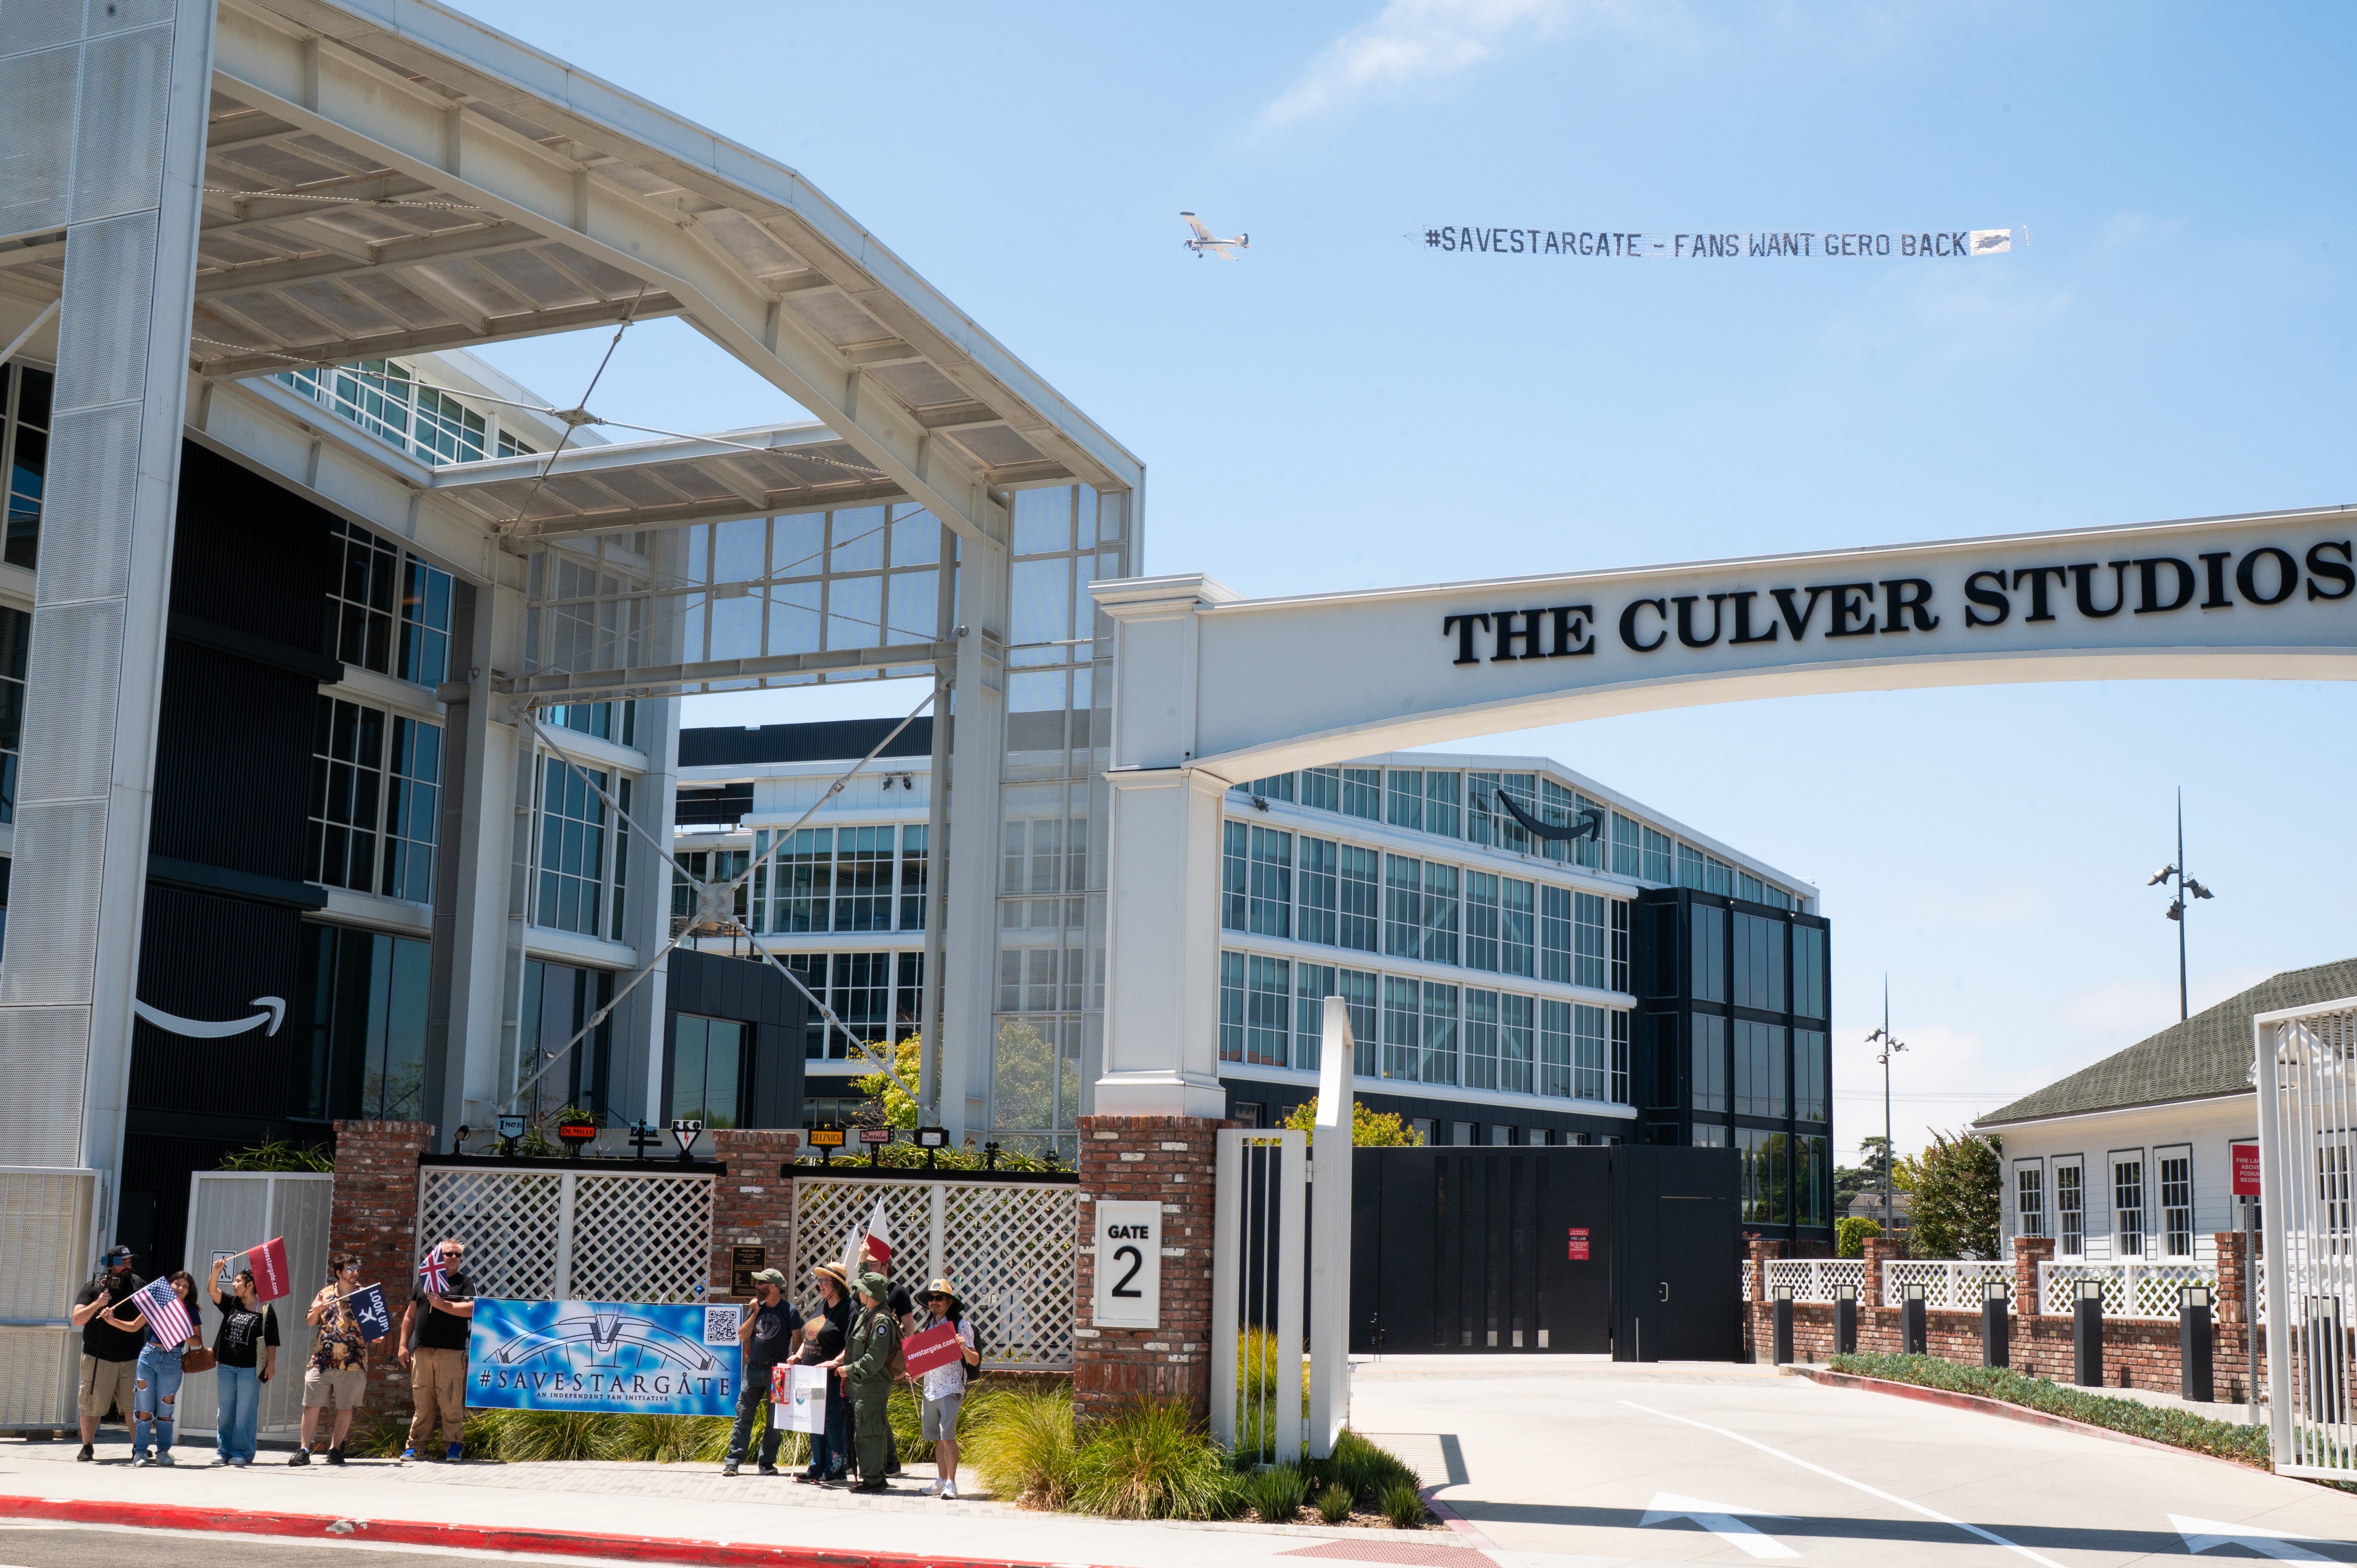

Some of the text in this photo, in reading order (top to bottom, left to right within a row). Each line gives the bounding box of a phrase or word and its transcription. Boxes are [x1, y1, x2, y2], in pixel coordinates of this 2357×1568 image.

[1425, 226, 1641, 257] #SAVESTARGATE
[1675, 234, 1739, 257] FANS
[1749, 233, 1814, 257] WANT
[1825, 234, 1890, 257] GERO
[1902, 232, 1968, 257] BACK
[1443, 541, 2356, 665] THE CULVER STUDIOS
[673, 1120, 700, 1130] RKO
[812, 1133, 841, 1142] SELZNICK
[862, 1131, 887, 1140] Desilu
[1108, 1225, 1149, 1239] GATE
[263, 1244, 278, 1295] savestargate.com
[1112, 1246, 1142, 1298] 2
[369, 1289, 389, 1332] LOOK UP!
[907, 1338, 956, 1360] savestargate.com
